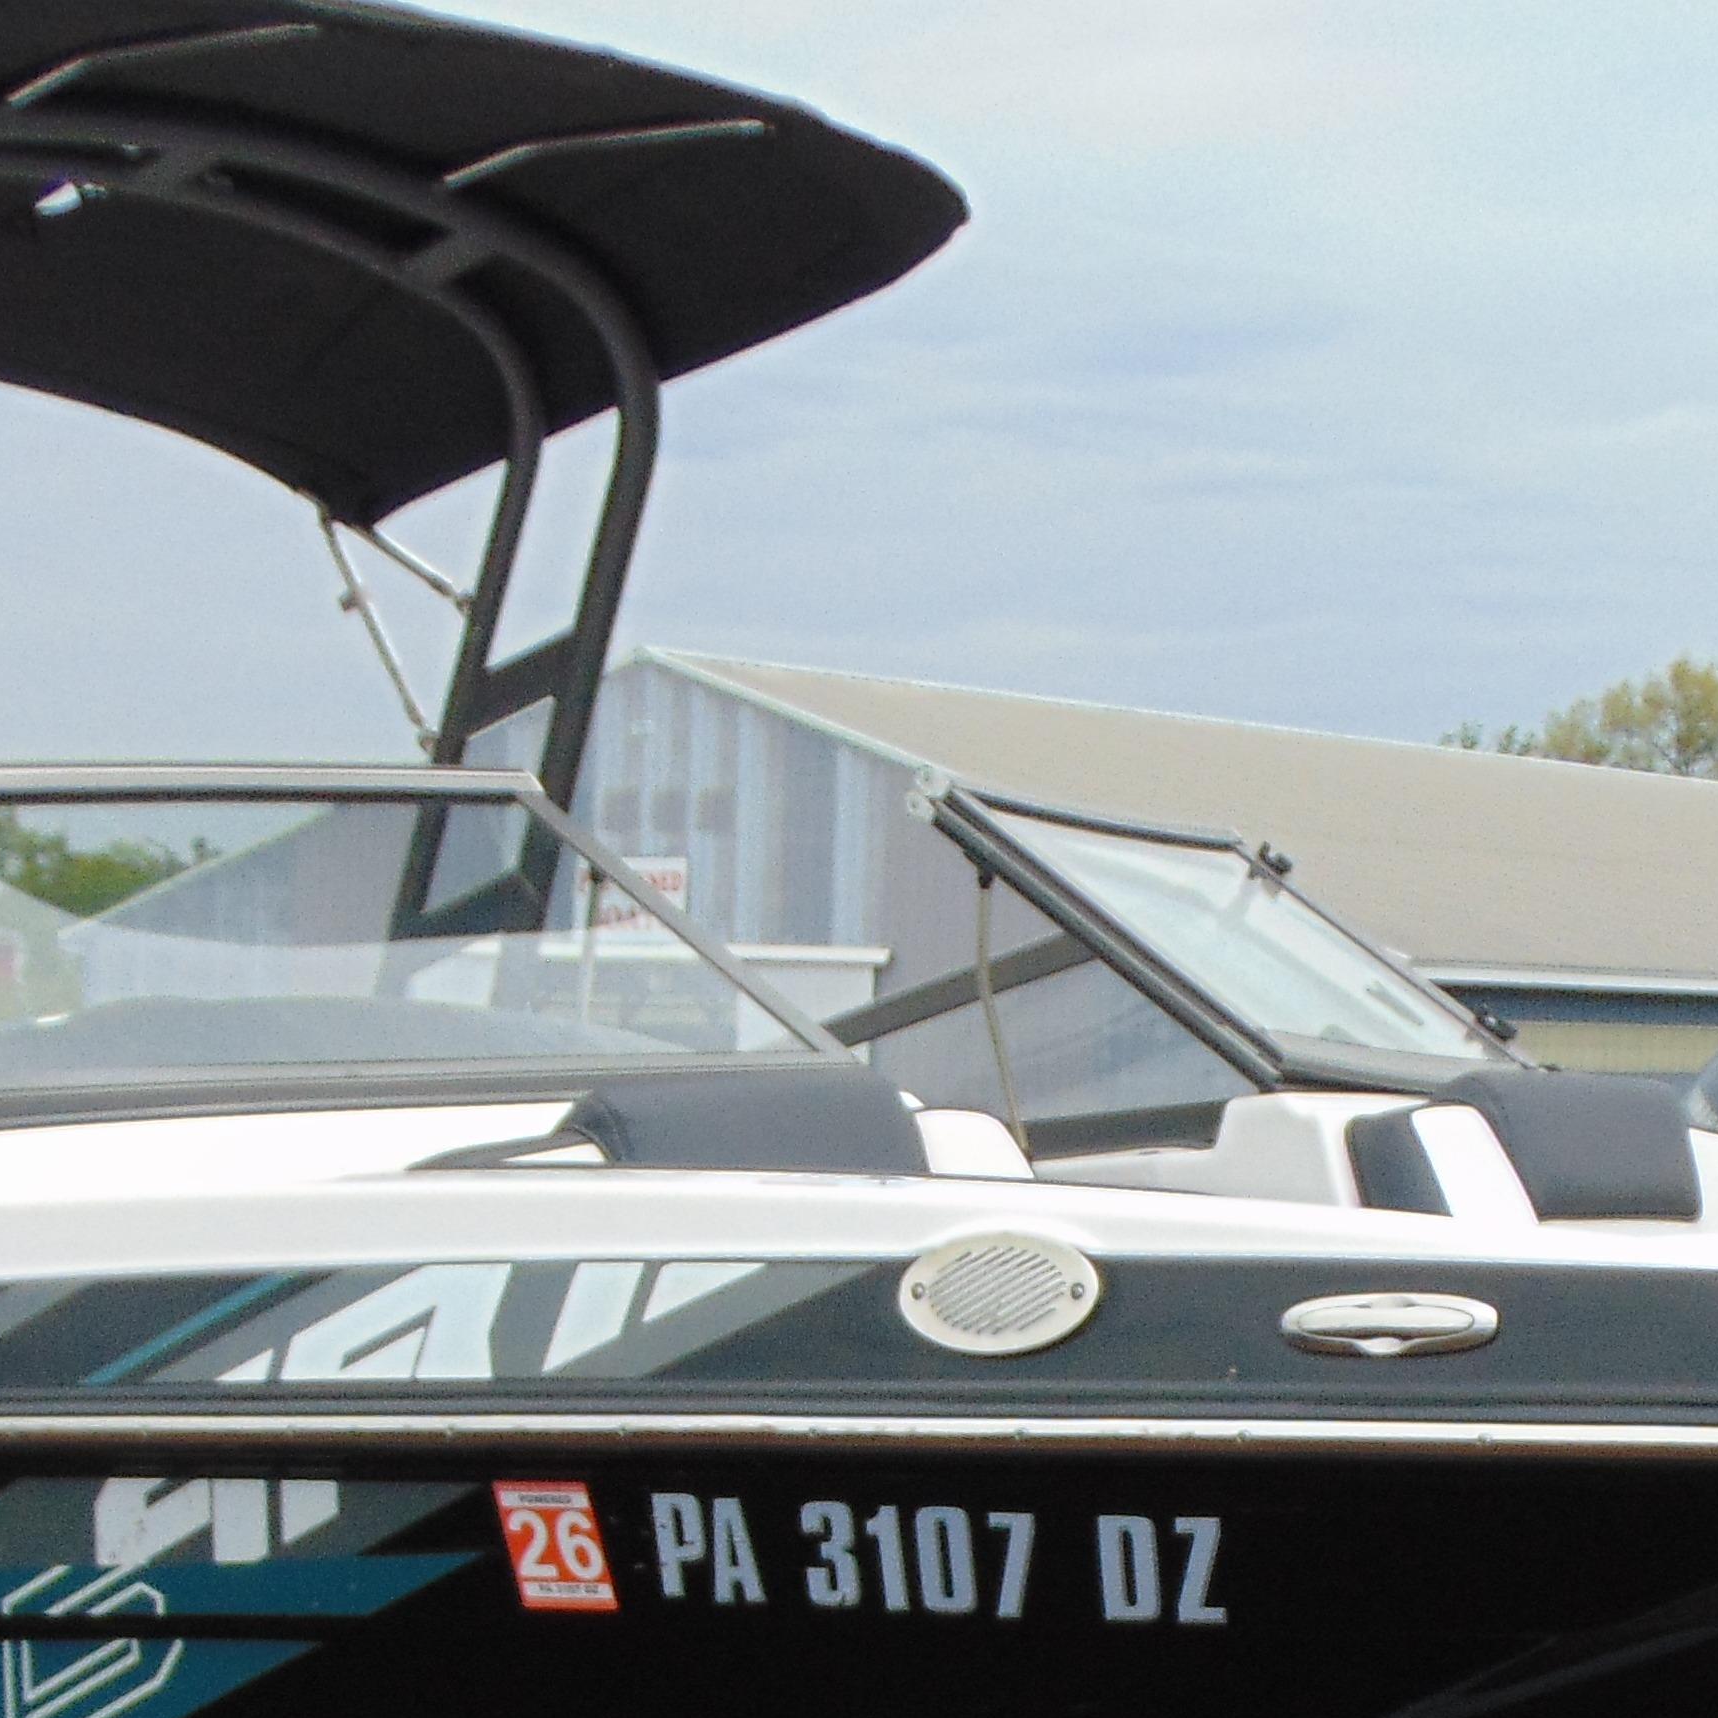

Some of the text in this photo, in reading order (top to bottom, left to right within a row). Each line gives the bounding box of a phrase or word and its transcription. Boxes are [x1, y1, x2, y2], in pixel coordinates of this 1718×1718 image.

[509, 1509, 604, 1580] 26
[651, 1492, 1228, 1624] PA 3107 DZ
